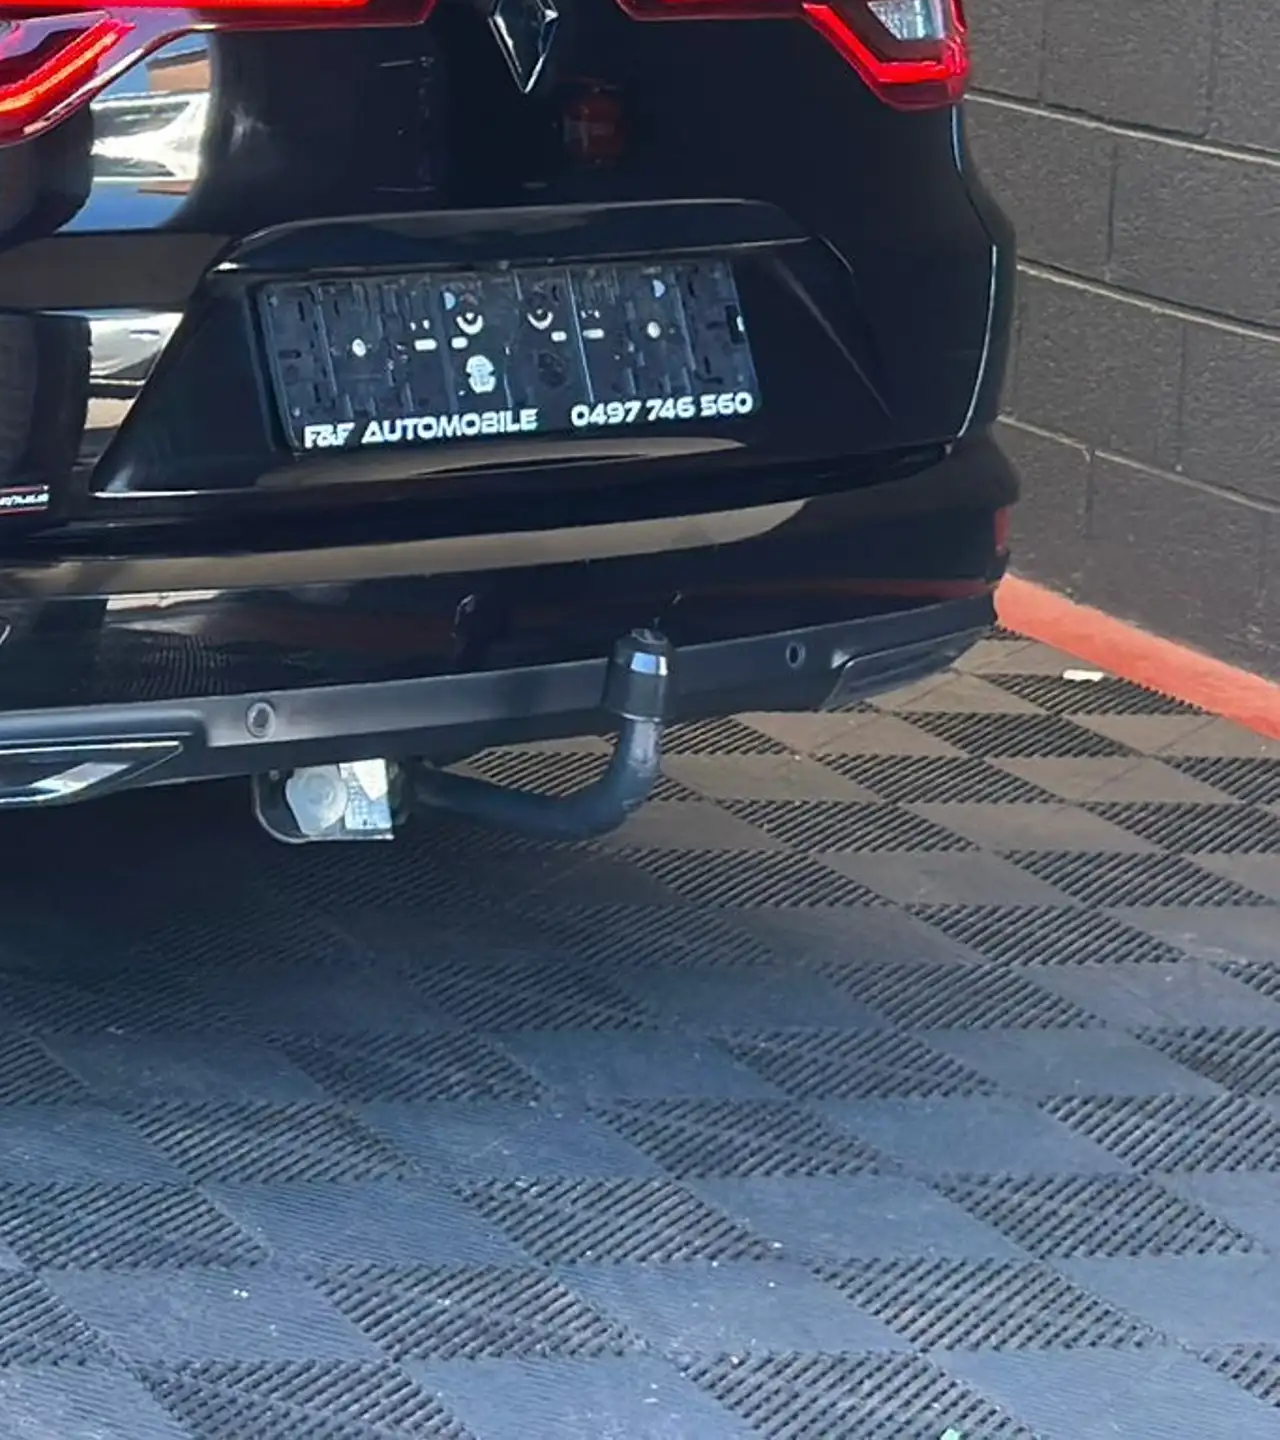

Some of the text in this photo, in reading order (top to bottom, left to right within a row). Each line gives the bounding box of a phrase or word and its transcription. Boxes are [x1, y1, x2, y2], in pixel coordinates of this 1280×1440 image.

[303, 391, 754, 450] F&F AUTOMOBILE 0497 746 560
